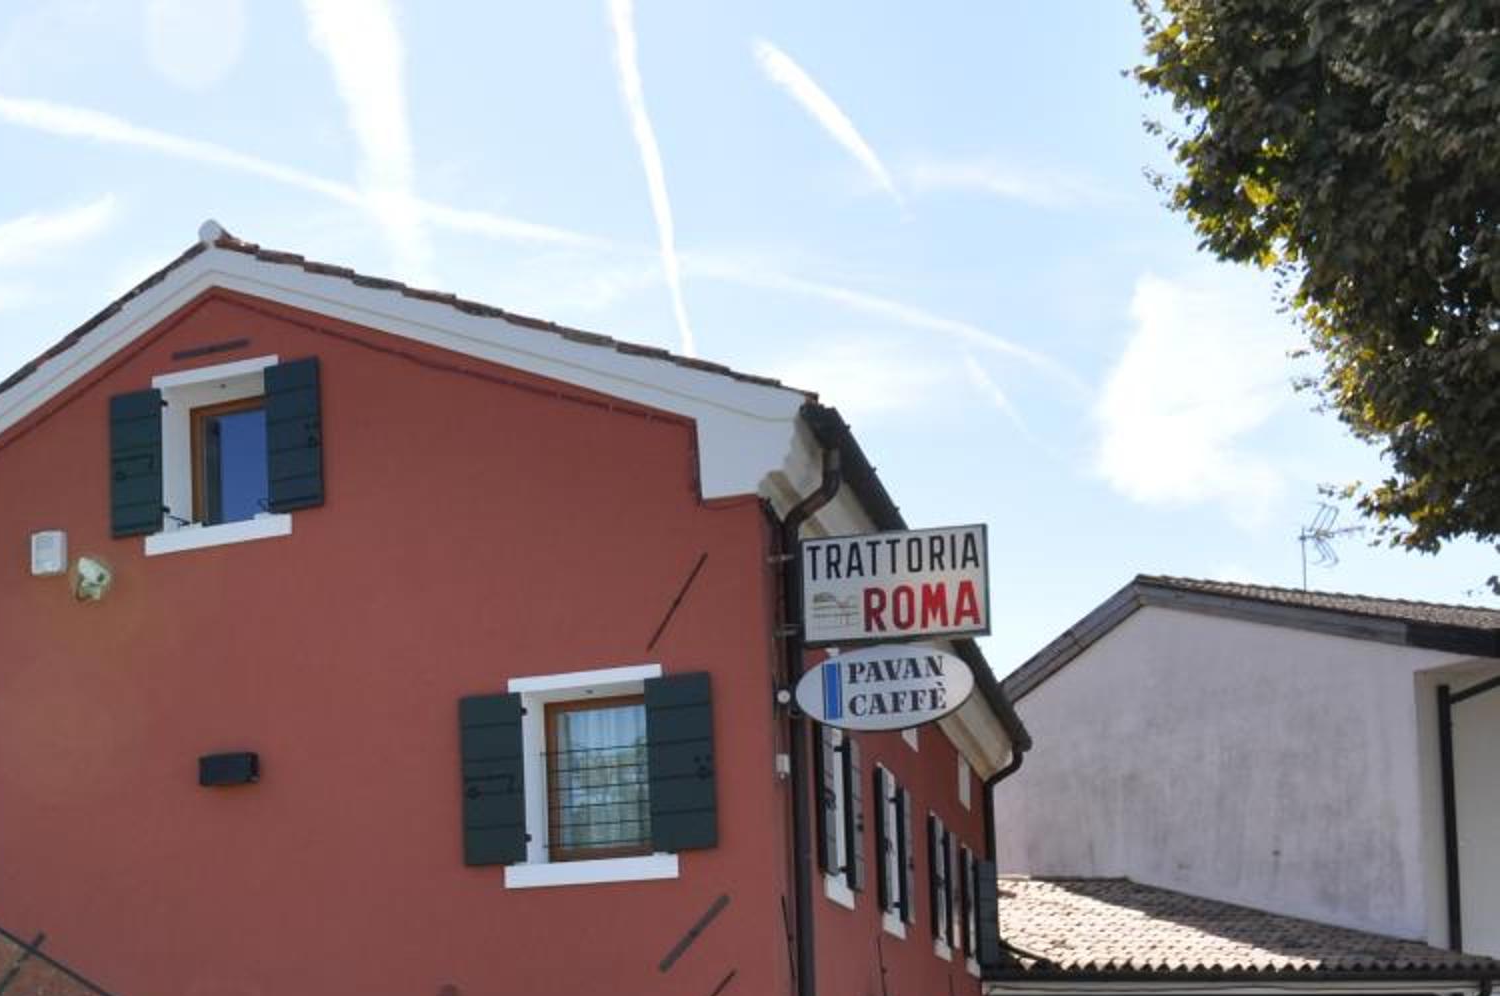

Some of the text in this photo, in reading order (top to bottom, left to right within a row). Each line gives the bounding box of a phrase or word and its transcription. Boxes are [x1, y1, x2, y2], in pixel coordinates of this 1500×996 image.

[807, 532, 980, 580] TRATTORIA
[863, 580, 981, 632] ROMA
[848, 655, 945, 683] PAVAN
[849, 681, 946, 716] CAFFÈ
